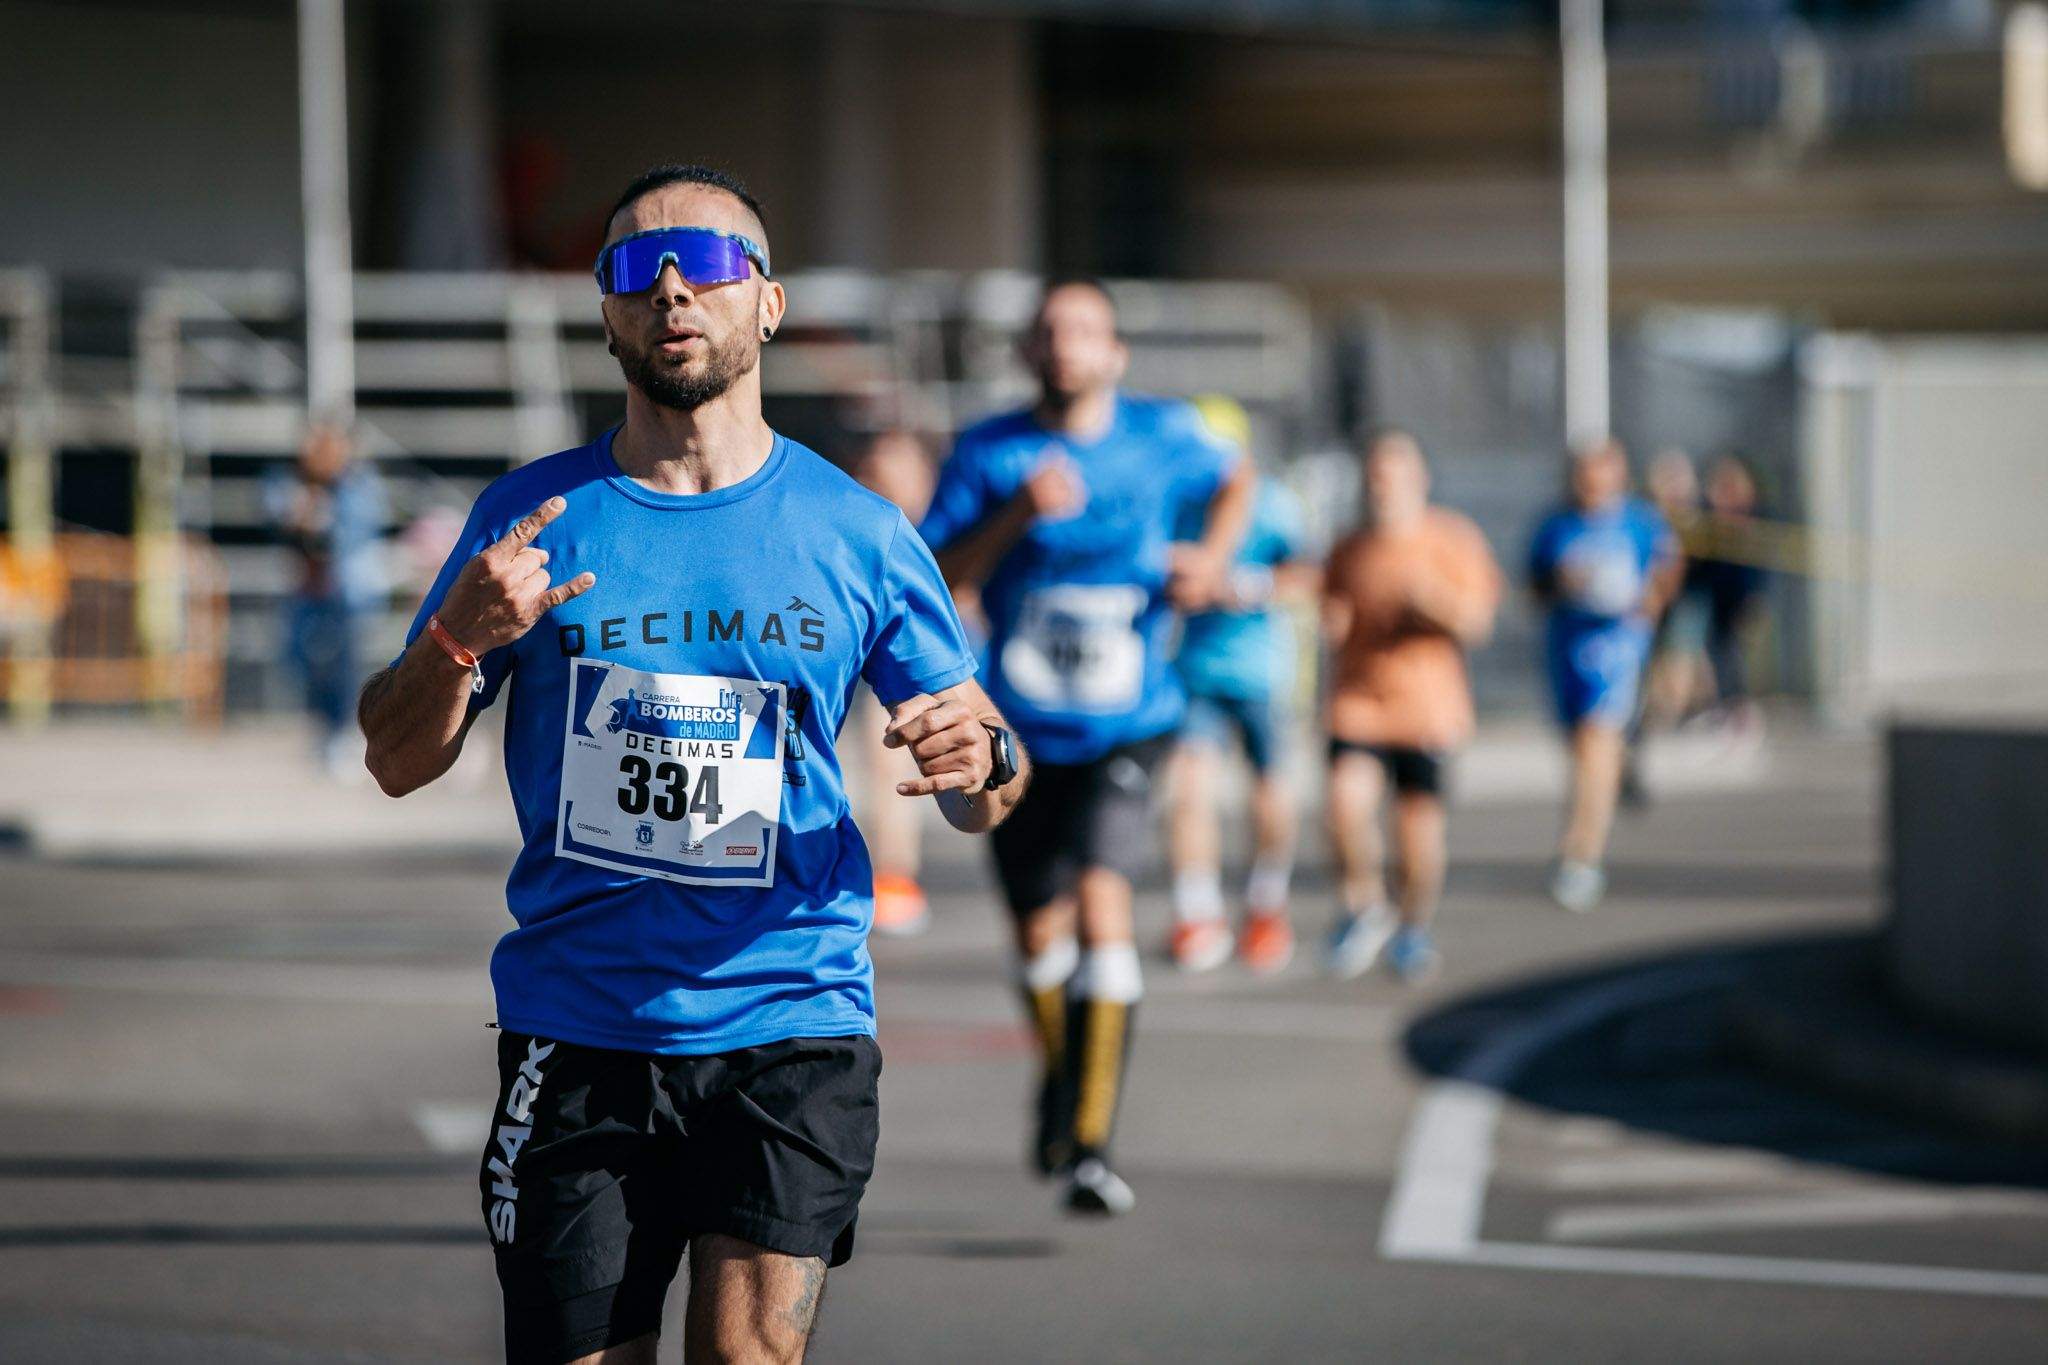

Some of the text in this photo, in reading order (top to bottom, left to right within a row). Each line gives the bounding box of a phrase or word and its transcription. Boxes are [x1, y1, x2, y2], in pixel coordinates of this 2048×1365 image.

[559, 610, 825, 656] DECIMAS
[642, 693, 680, 704] CARRERA
[640, 702, 736, 723] BOMBEROS
[680, 722, 737, 739] de MADRID
[626, 733, 733, 759] DECIMAS
[617, 755, 723, 824] 334
[488, 1037, 557, 1245] SHARK
